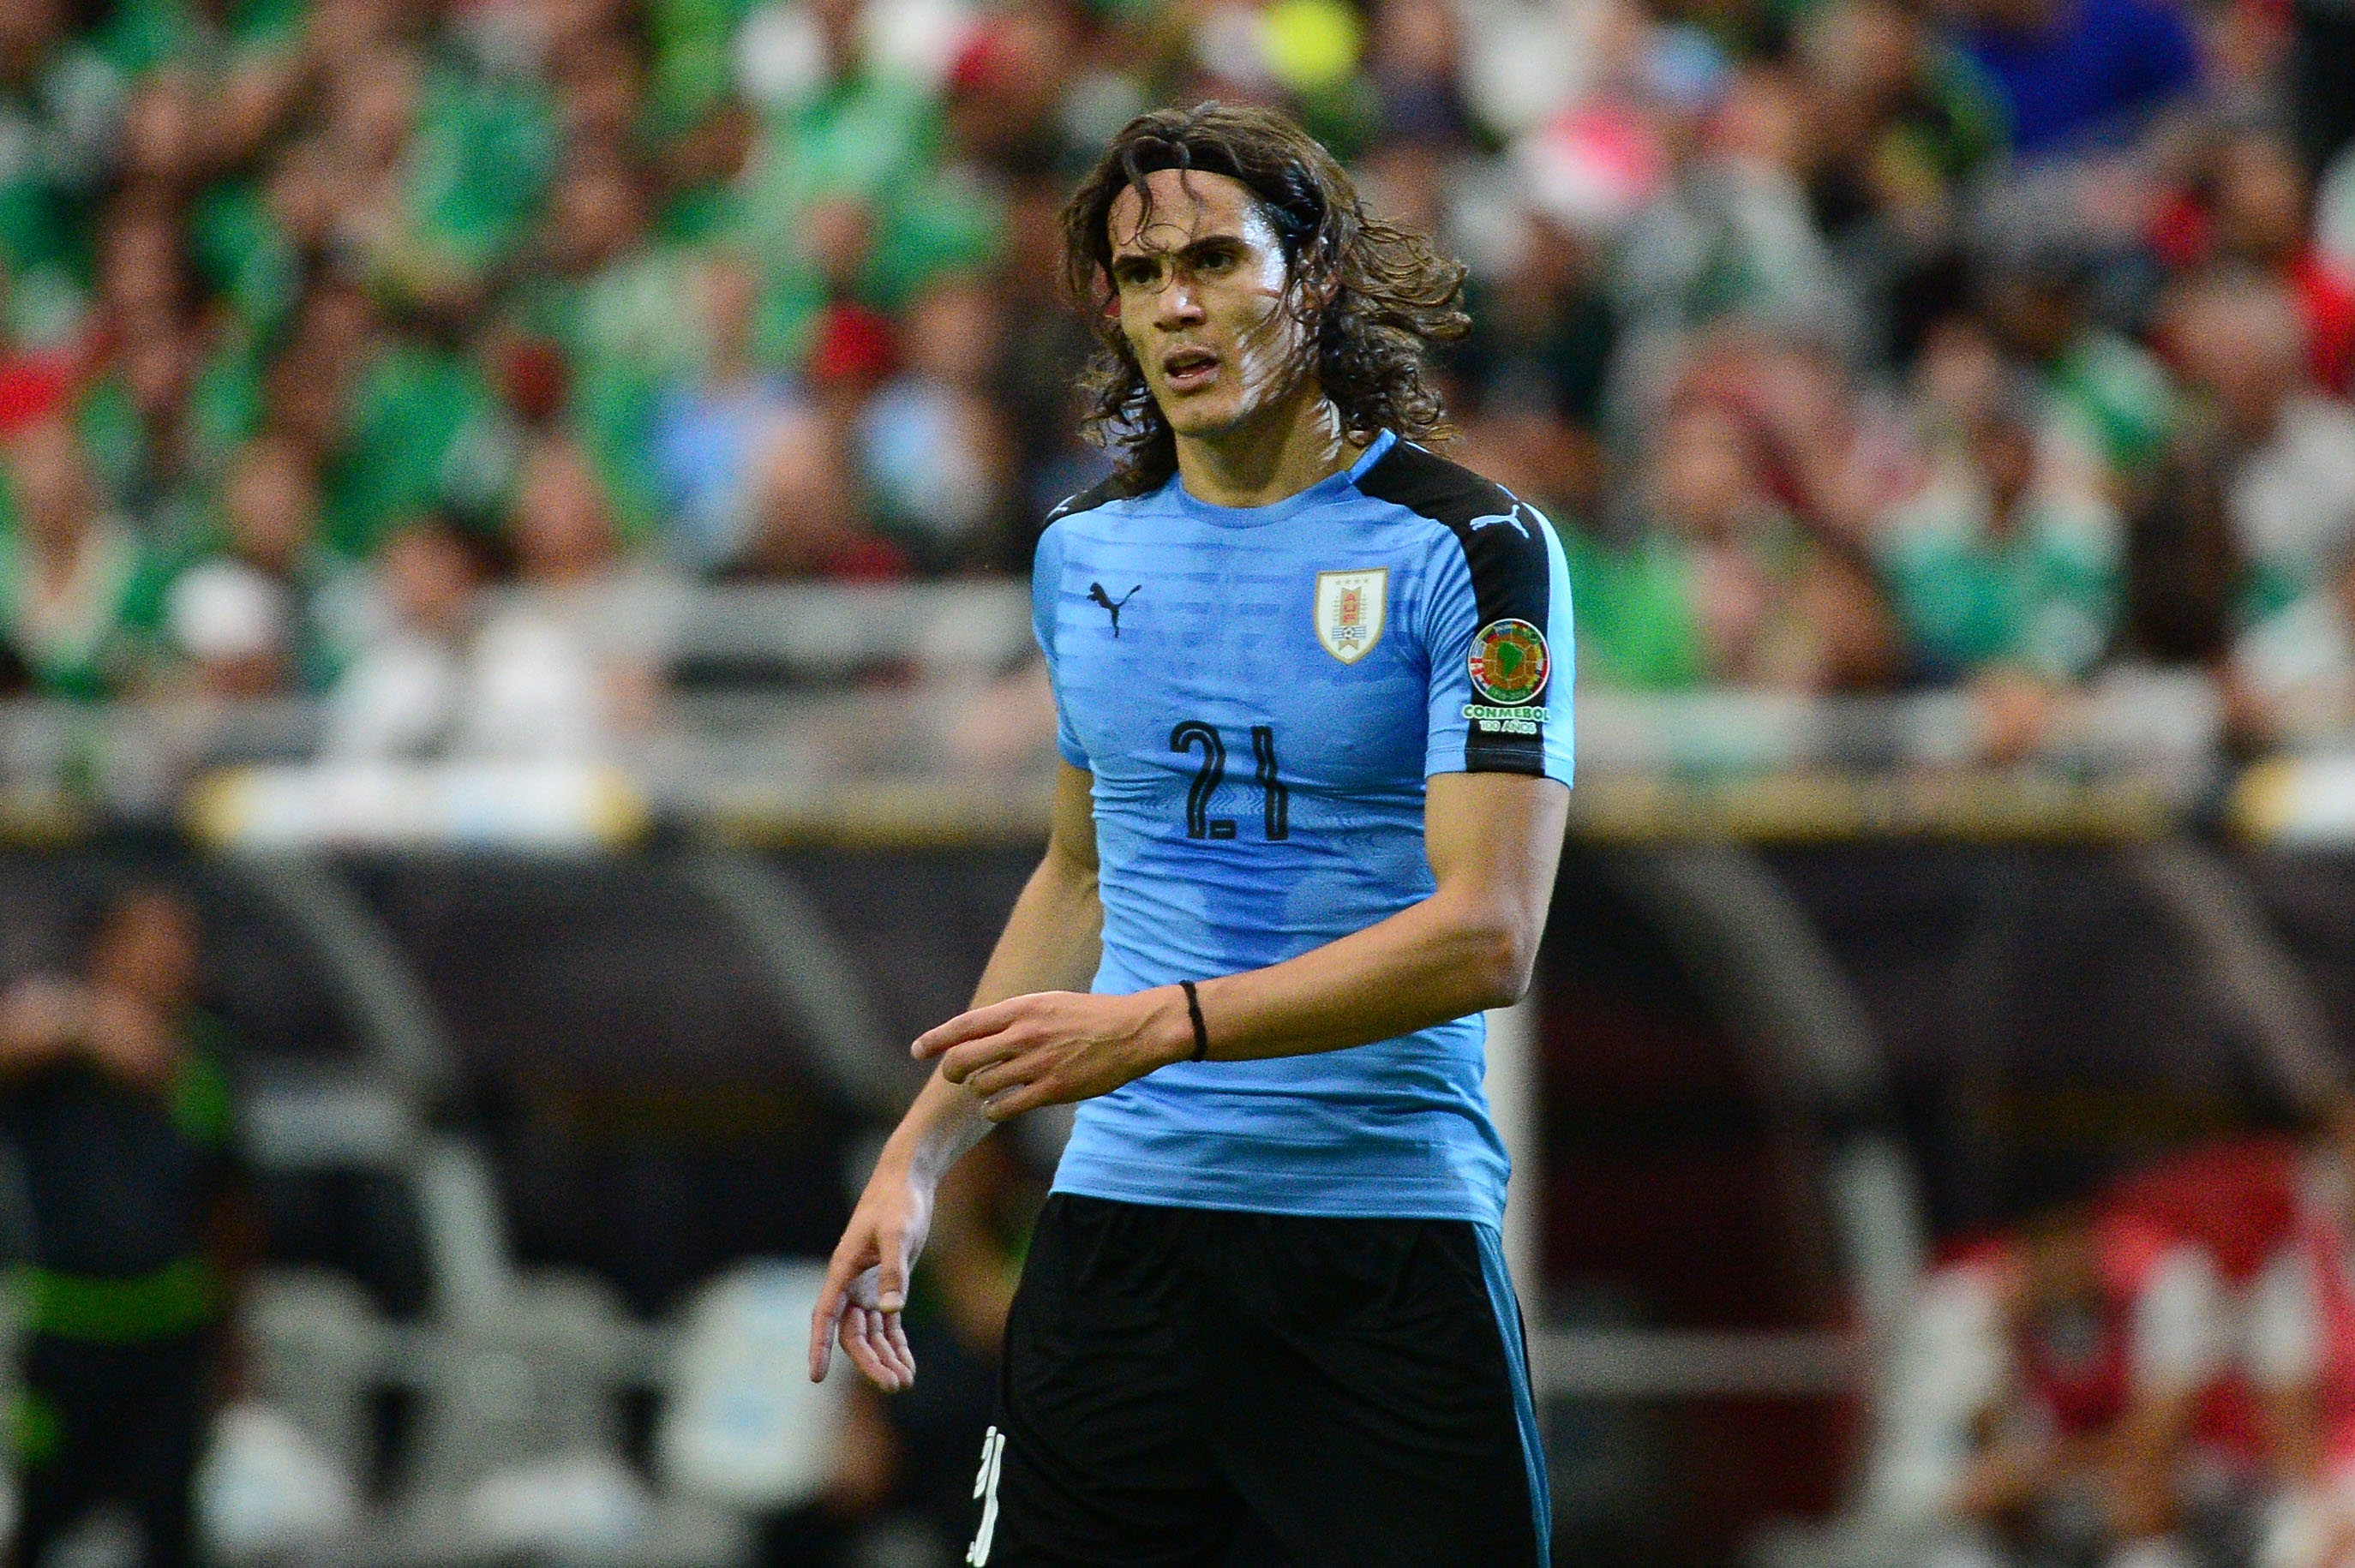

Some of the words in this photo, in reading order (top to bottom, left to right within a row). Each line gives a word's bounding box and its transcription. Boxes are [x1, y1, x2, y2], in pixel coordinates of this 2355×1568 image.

[1463, 704, 1549, 722] CONMEBOL
[1479, 720, 1501, 732] 100
[1170, 720, 1288, 841] 21
